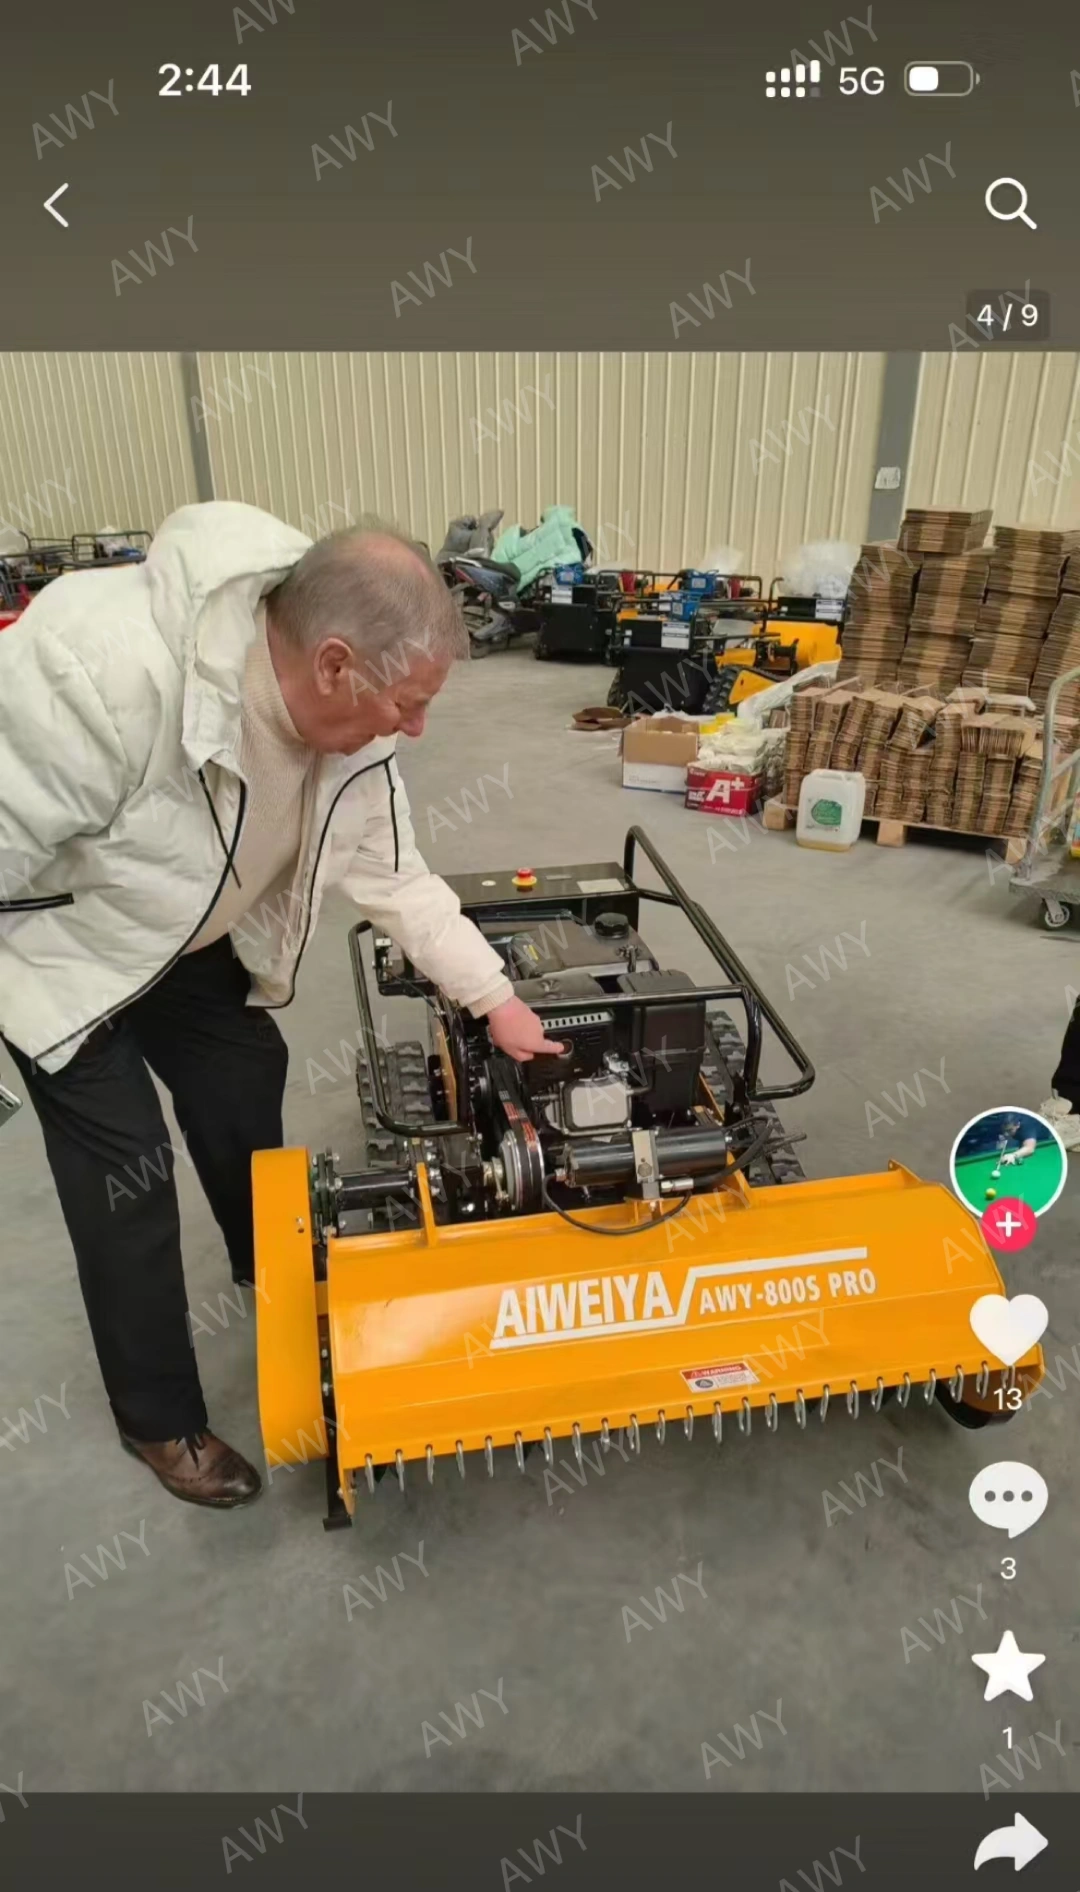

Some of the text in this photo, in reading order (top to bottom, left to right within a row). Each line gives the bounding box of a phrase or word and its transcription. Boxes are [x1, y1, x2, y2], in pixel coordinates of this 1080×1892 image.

[706, 777, 745, 804] A+
[493, 1270, 675, 1340] AIWEIYA
[699, 1267, 877, 1316] AWY-800S PRO
